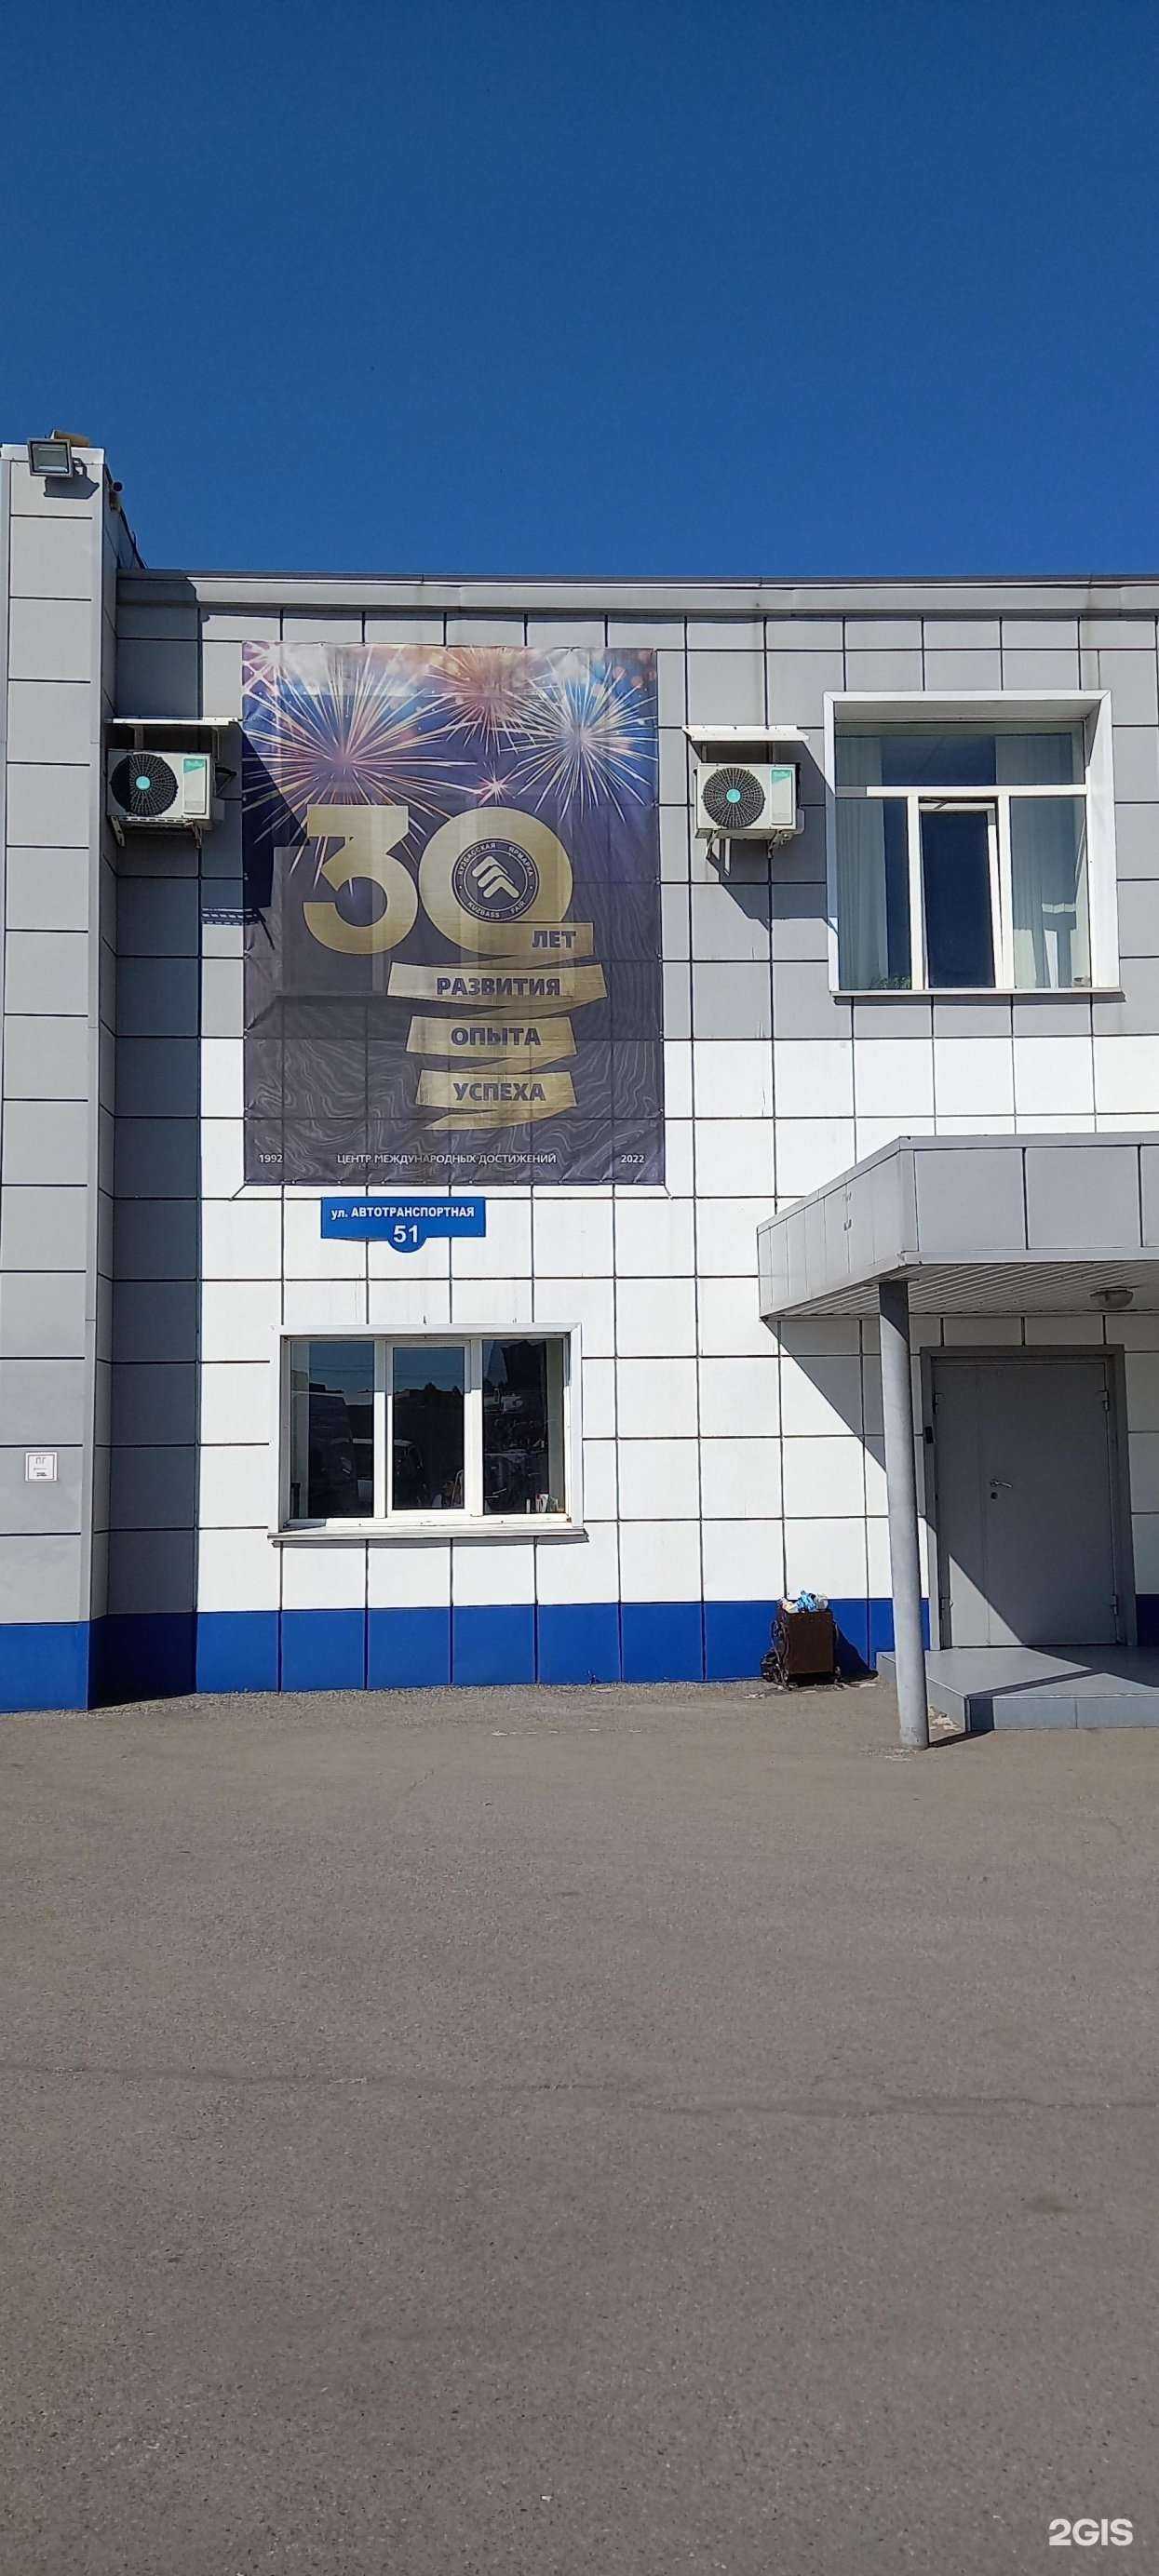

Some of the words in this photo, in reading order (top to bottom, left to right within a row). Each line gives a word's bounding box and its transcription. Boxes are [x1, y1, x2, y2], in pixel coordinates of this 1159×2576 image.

[458, 842, 496, 875] КУЗБАССКАЯ
[508, 846, 534, 877] ЯРМАРКА
[303, 803, 573, 956] 30
[467, 901, 500, 918] KUZBASS
[510, 901, 526, 914] FAIR
[531, 930, 576, 949] ЛЕТ
[436, 977, 560, 998] РАЗВИТИЯ
[451, 1027, 541, 1046] ОПЫТА
[453, 1082, 546, 1102] УСПЕХА
[259, 1154, 283, 1163] 1992
[337, 1154, 371, 1164] ЦЕНТР
[374, 1154, 476, 1164] МЕЖДУНАРОДНЫХ
[478, 1152, 557, 1163] ДОСТИЖЕНИЙ
[620, 1154, 645, 1163] 2022
[331, 1209, 348, 1219] ул.
[351, 1207, 475, 1218] АВТОТРАНСПОРТНАЯ
[393, 1225, 419, 1244] 51
